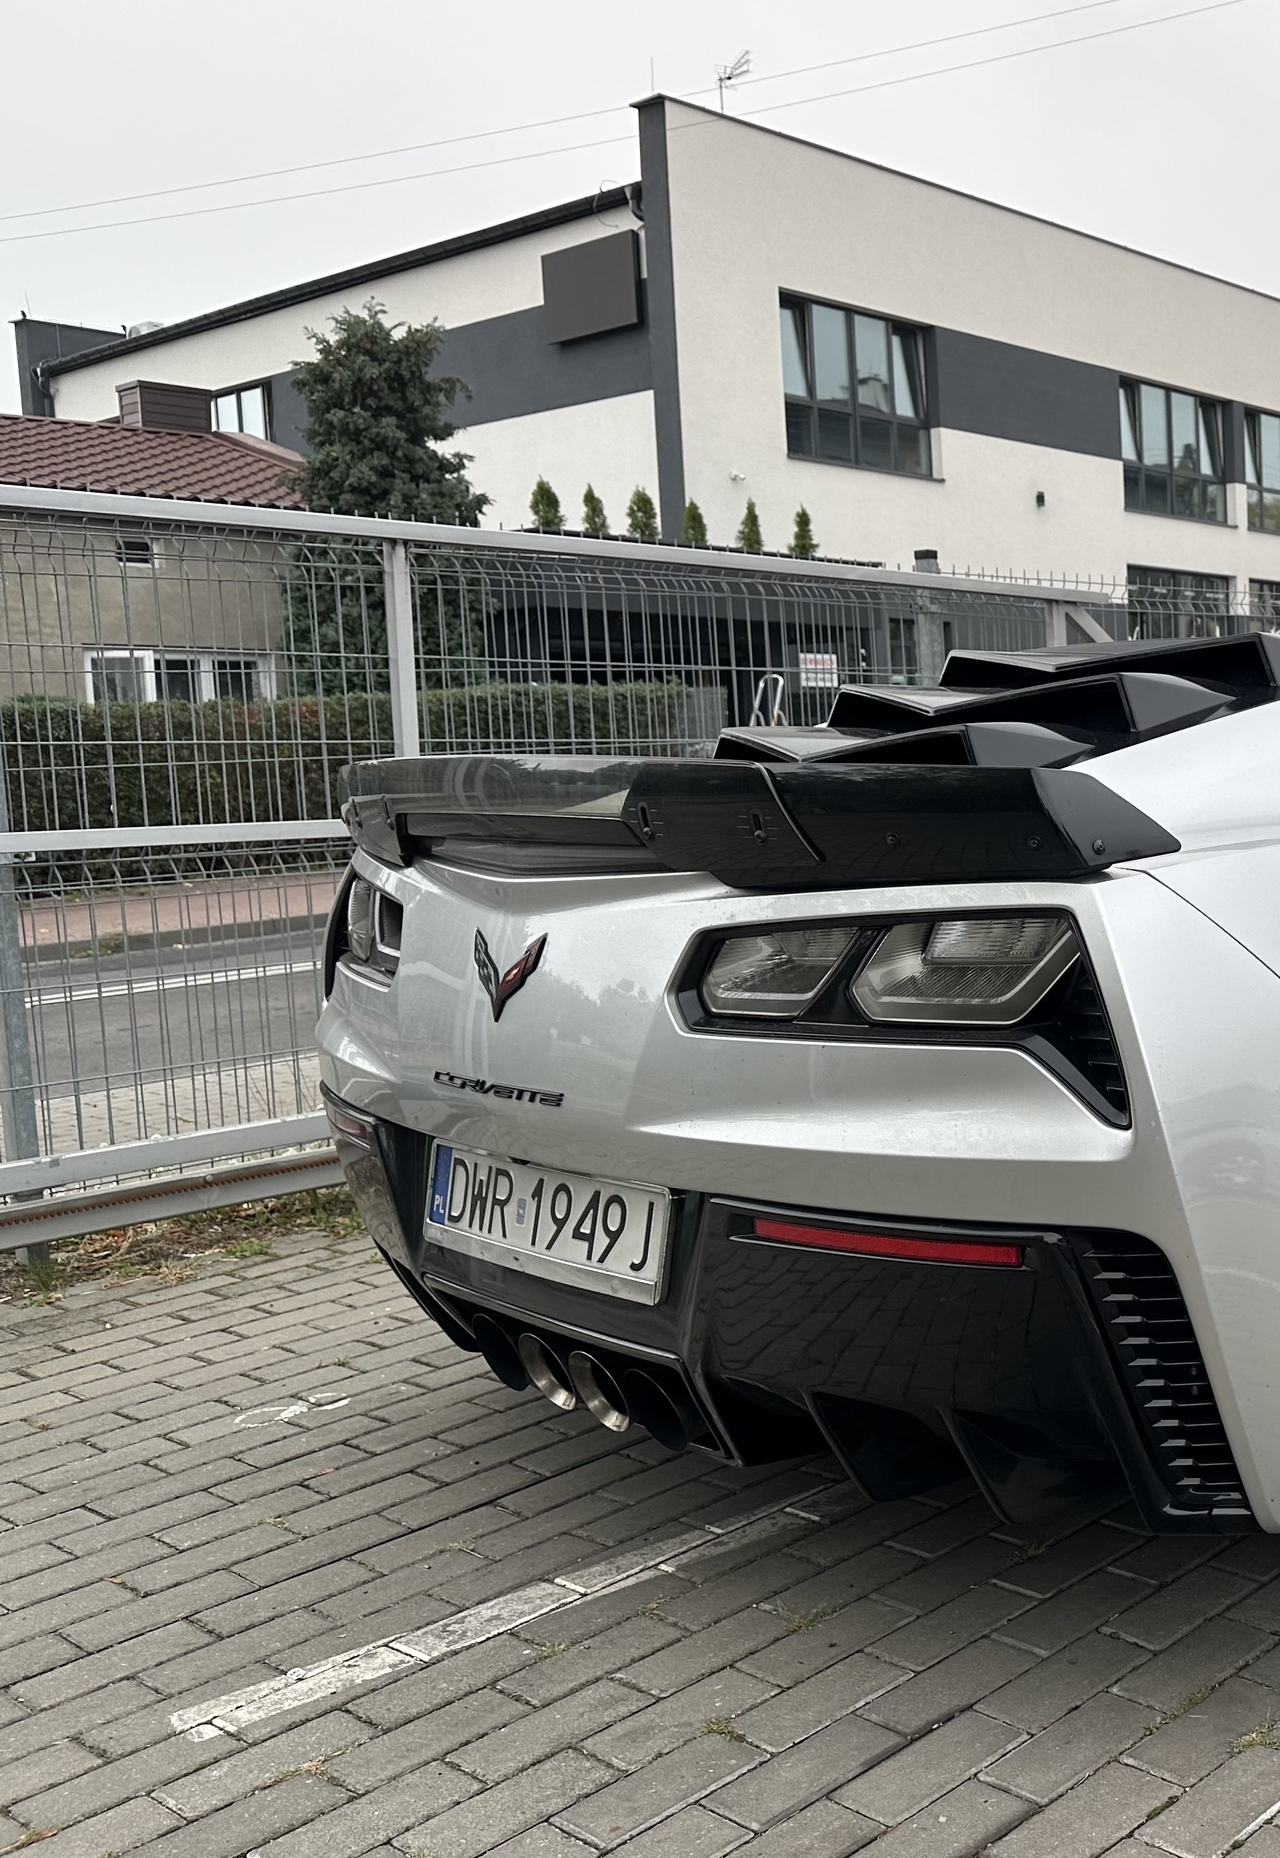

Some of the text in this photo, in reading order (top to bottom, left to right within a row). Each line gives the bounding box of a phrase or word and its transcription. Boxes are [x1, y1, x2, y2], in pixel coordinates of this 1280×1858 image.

[434, 1070, 564, 1107] CORVETTE
[433, 1194, 445, 1214] PL
[447, 1158, 655, 1272] DWR 1949J
